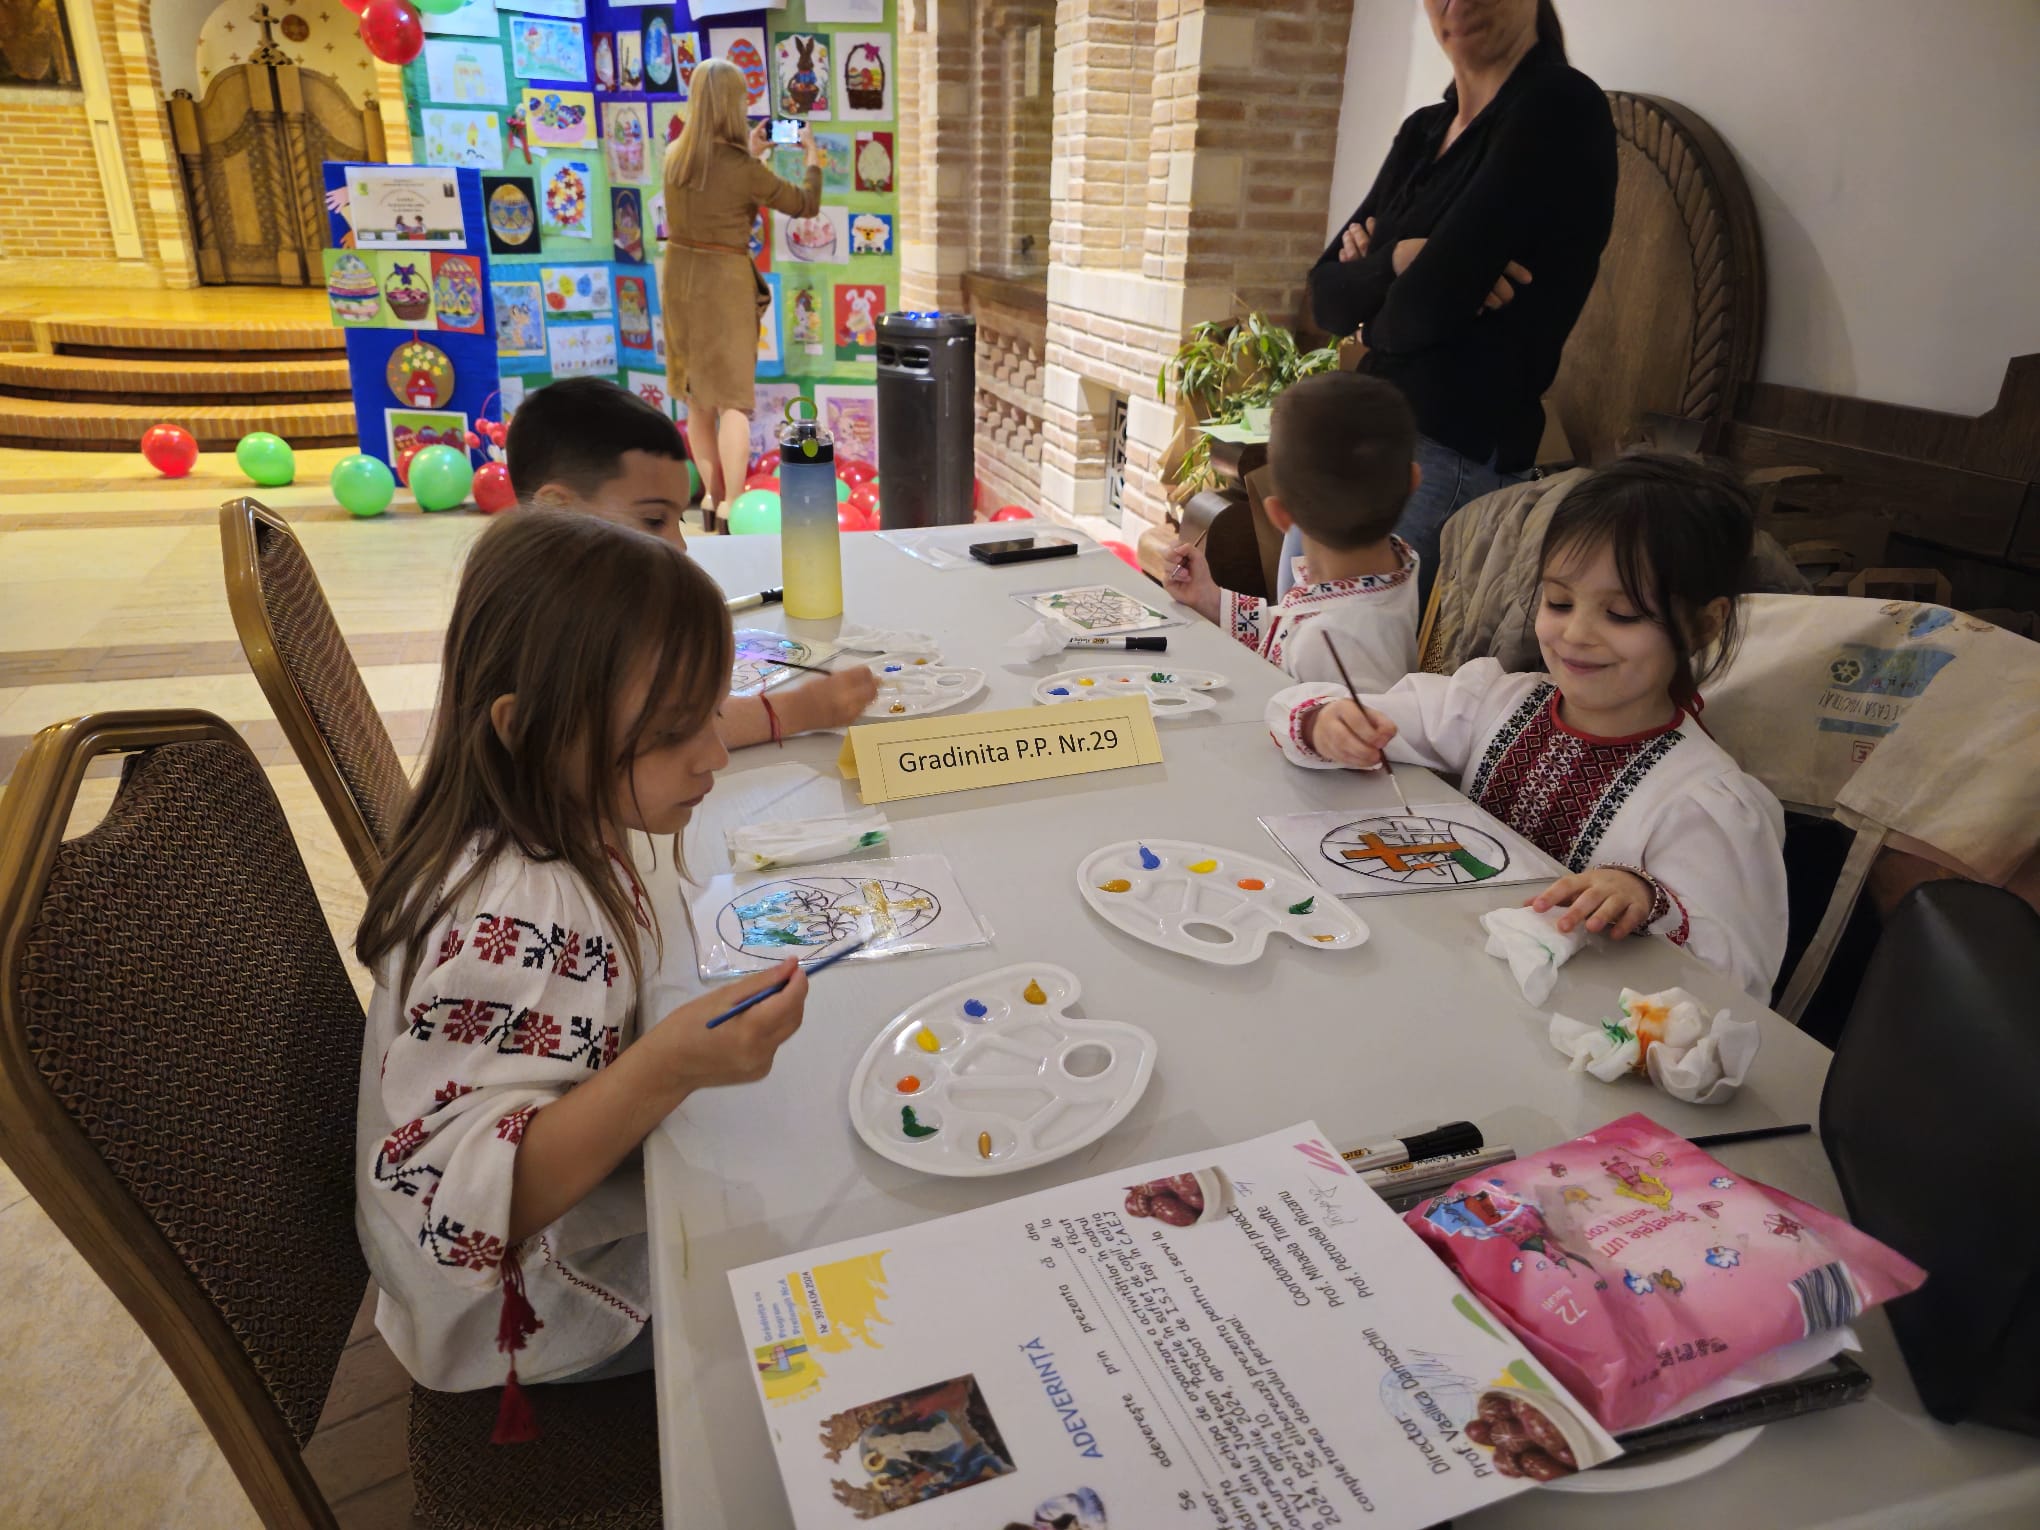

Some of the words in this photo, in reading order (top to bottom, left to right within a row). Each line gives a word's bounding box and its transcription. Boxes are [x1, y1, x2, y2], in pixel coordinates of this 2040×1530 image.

[898, 745, 1009, 773] Gradinita
[1016, 737, 1052, 759] P.P.
[1059, 729, 1118, 754] Nr.29
[1040, 1218, 1053, 1229] la
[1257, 1206, 1290, 1242] Timofte
[1278, 1190, 1313, 1226] Pînzariu
[1024, 1222, 1040, 1241] dna
[1058, 1218, 1082, 1245] făcut
[1074, 1217, 1101, 1248] cadrul
[1151, 1230, 1164, 1241] la
[1308, 1226, 1351, 1271] Petronela
[1039, 1256, 1056, 1268] că
[1077, 1246, 1087, 1254] a
[1097, 1249, 1109, 1262] în
[1129, 1247, 1141, 1260] în
[1157, 1242, 1182, 1267] servi
[1286, 1242, 1323, 1280] Mihaela
[1127, 1274, 1144, 1288] de
[1178, 1269, 1194, 1283] a-i
[1254, 1241, 1310, 1306] Coordonatori
[1344, 1272, 1374, 1298] Prof.
[1058, 1284, 1096, 1333] prezenta
[1139, 1291, 1167, 1324] suflet
[1189, 1285, 1223, 1322] pentru
[1315, 1281, 1344, 1308] Prof.
[1554, 1298, 1587, 1325] 72
[1146, 1327, 1157, 1336] a
[1162, 1325, 1175, 1339] în
[1175, 1317, 1190, 1332] de
[1222, 1314, 1272, 1366] personal.
[1096, 1350, 1120, 1375] prin
[1186, 1337, 1224, 1382] aprobat
[1216, 1324, 1262, 1377] prezenta
[1362, 1328, 1419, 1390] Damaschin
[1153, 1336, 1199, 1402] organizare
[1220, 1385, 1252, 1424] 2024,
[1251, 1379, 1306, 1446] eliberează
[1260, 1368, 1310, 1424] dosarului
[1122, 1393, 1171, 1467] adeverește
[1195, 1405, 1212, 1422] de
[1414, 1390, 1459, 1442] Vasilica
[1208, 1425, 1242, 1469] echipa
[1249, 1428, 1284, 1472] aprilie
[1303, 1449, 1322, 1469] Se
[1452, 1442, 1493, 1478] Prof.
[1238, 1473, 1259, 1496] din
[1307, 1427, 1374, 1512] completarea
[1178, 1489, 1197, 1511] Se
[1282, 1476, 1311, 1513] IV-a
[1304, 1480, 1341, 1526] 2024,
